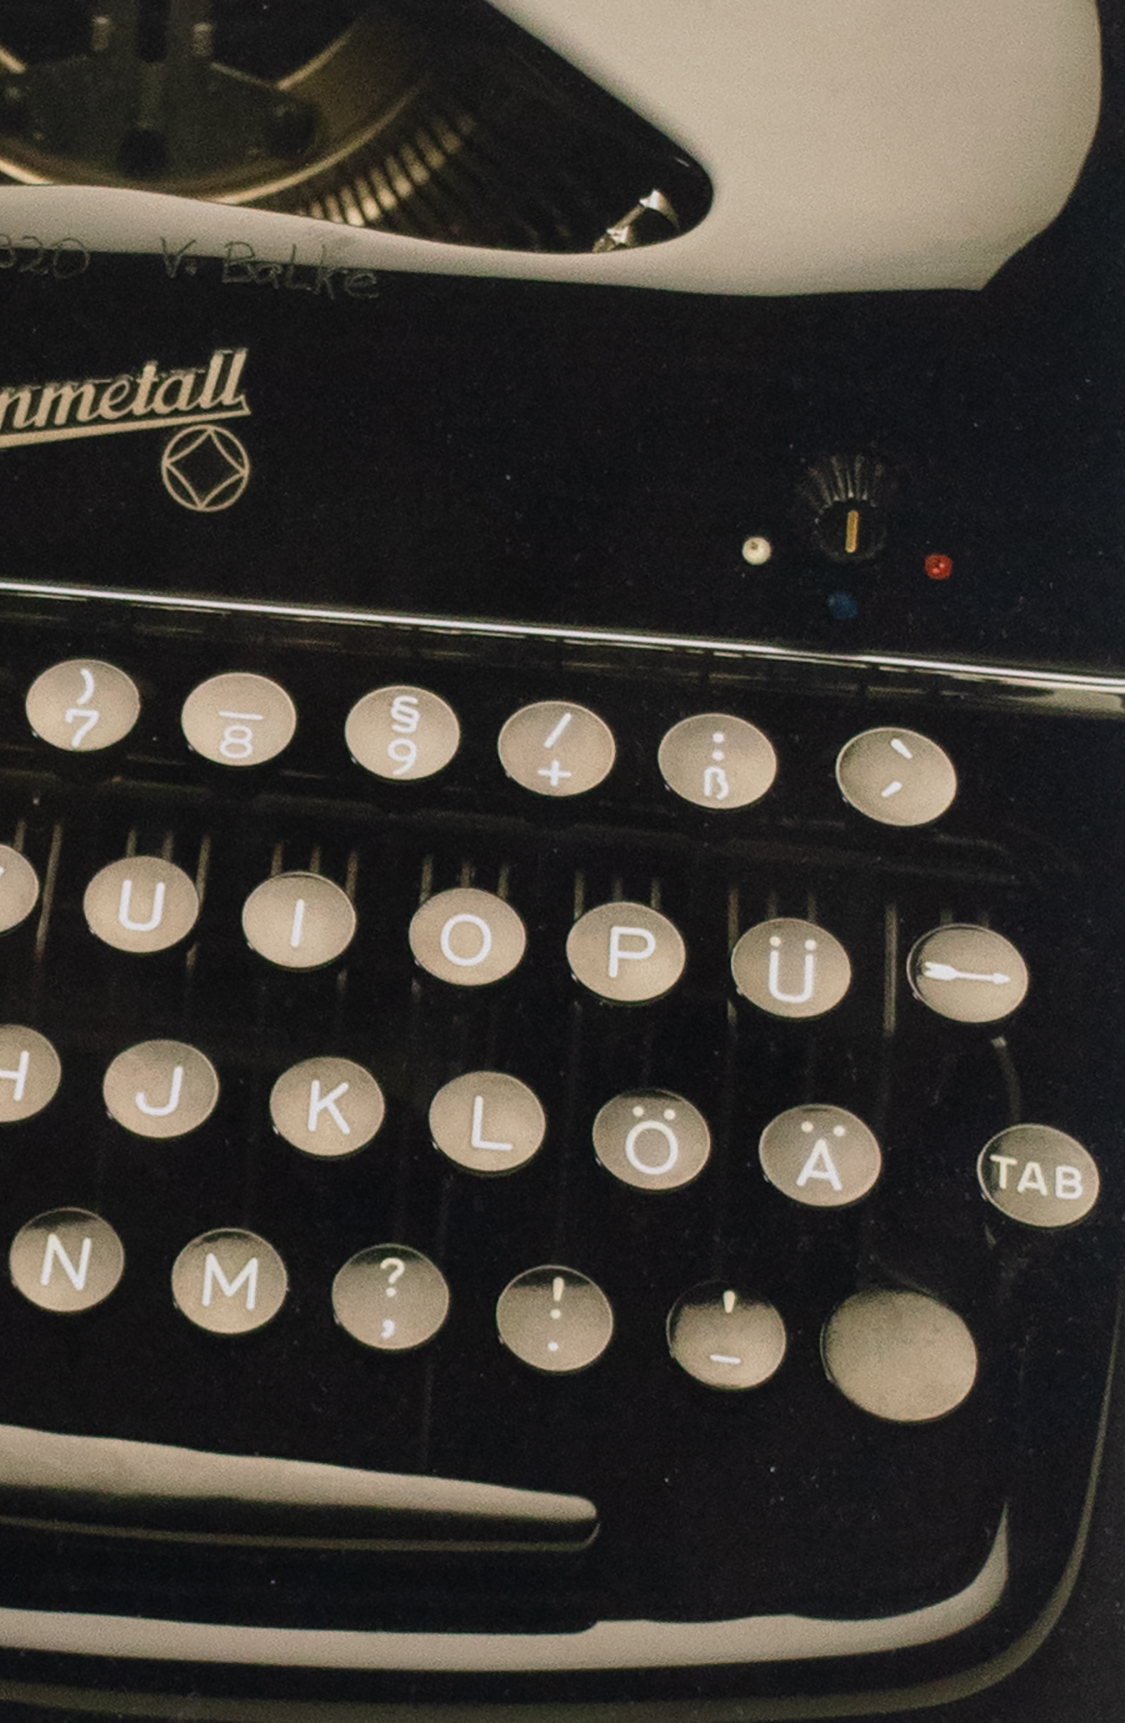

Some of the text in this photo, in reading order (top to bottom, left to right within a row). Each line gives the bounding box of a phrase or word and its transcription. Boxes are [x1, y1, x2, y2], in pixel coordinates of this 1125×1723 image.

[63, 707, 101, 749] 7
[217, 723, 255, 761] 8
[389, 694, 422, 736] §
[385, 736, 419, 777] 9
[116, 877, 167, 933] U
[288, 897, 307, 949] I
[439, 912, 494, 968] O
[607, 924, 658, 979] P
[767, 935, 818, 1005] Ü
[133, 1065, 185, 1118] J
[306, 1079, 352, 1136] K
[470, 1094, 515, 1153] L
[624, 1105, 681, 1177] Ö
[795, 1121, 847, 1193] Ä
[988, 1152, 1085, 1201] TAB
[39, 1233, 92, 1292] N
[200, 1252, 260, 1312] M
[379, 1256, 406, 1298] ?
[550, 1275, 566, 1320] !
